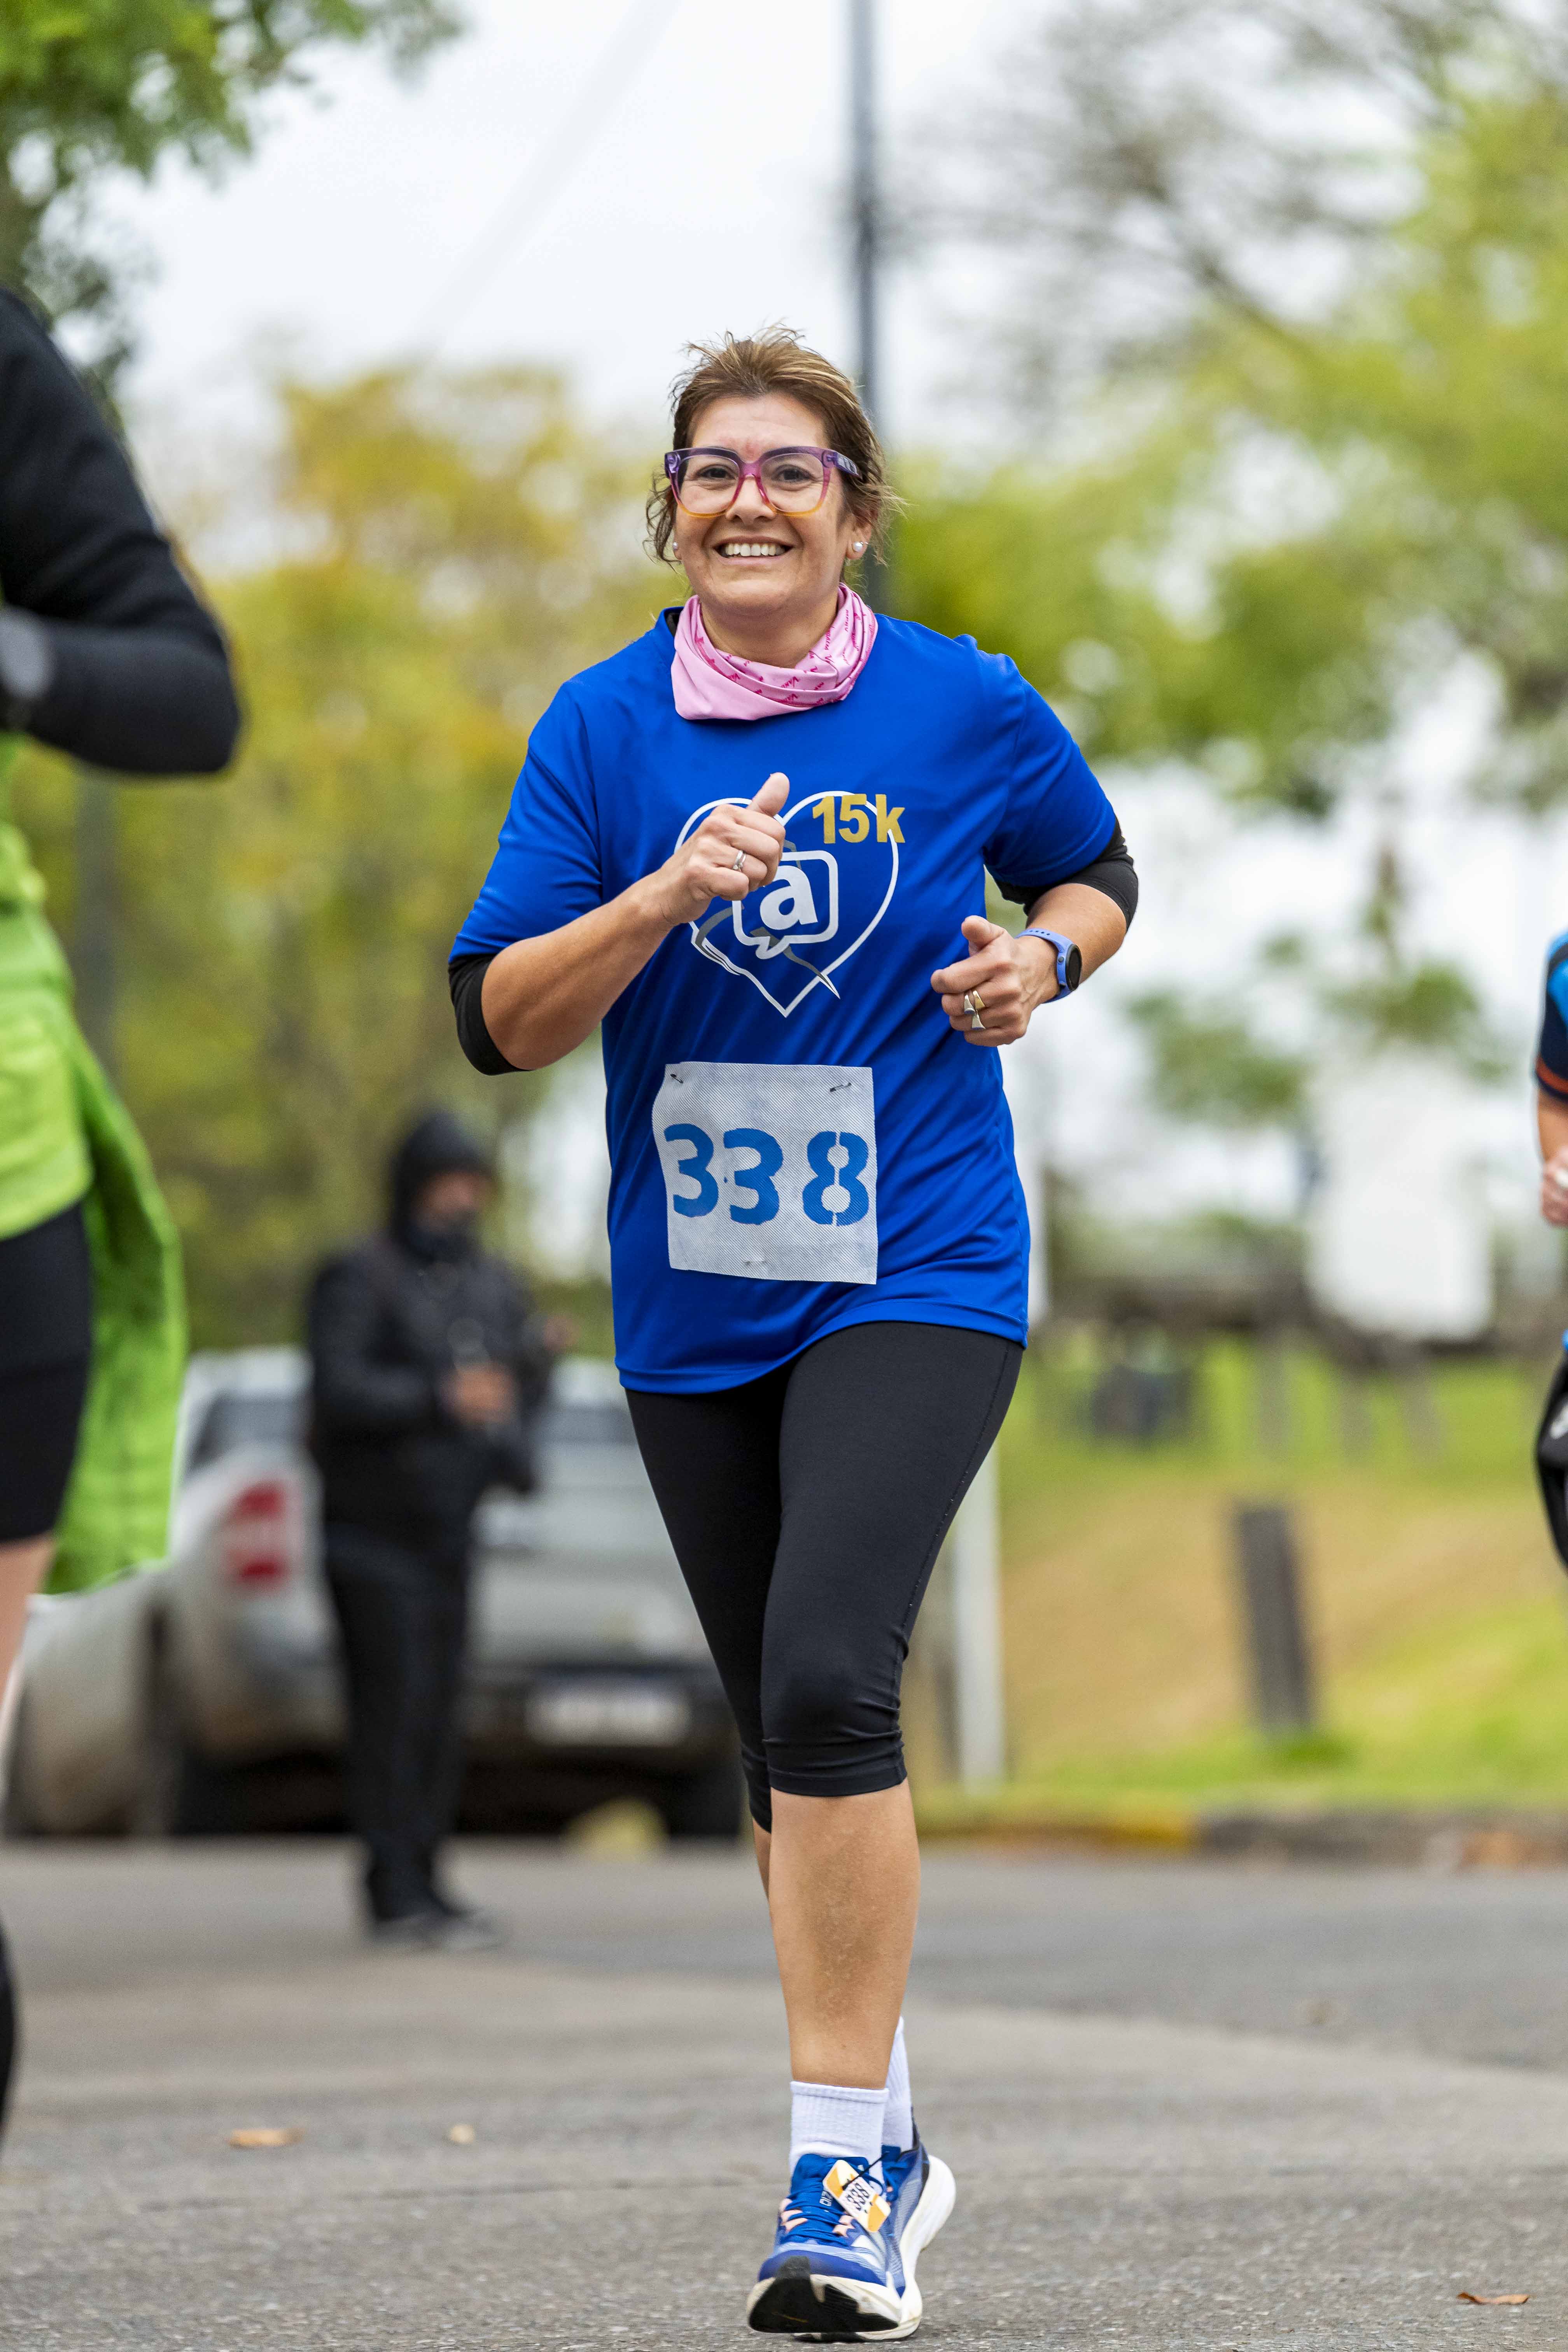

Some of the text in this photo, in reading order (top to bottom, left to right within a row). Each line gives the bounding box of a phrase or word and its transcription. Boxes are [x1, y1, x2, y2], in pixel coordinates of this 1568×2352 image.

[812, 794, 905, 844] 15k
[760, 865, 818, 930] a
[663, 1123, 870, 1226] 338
